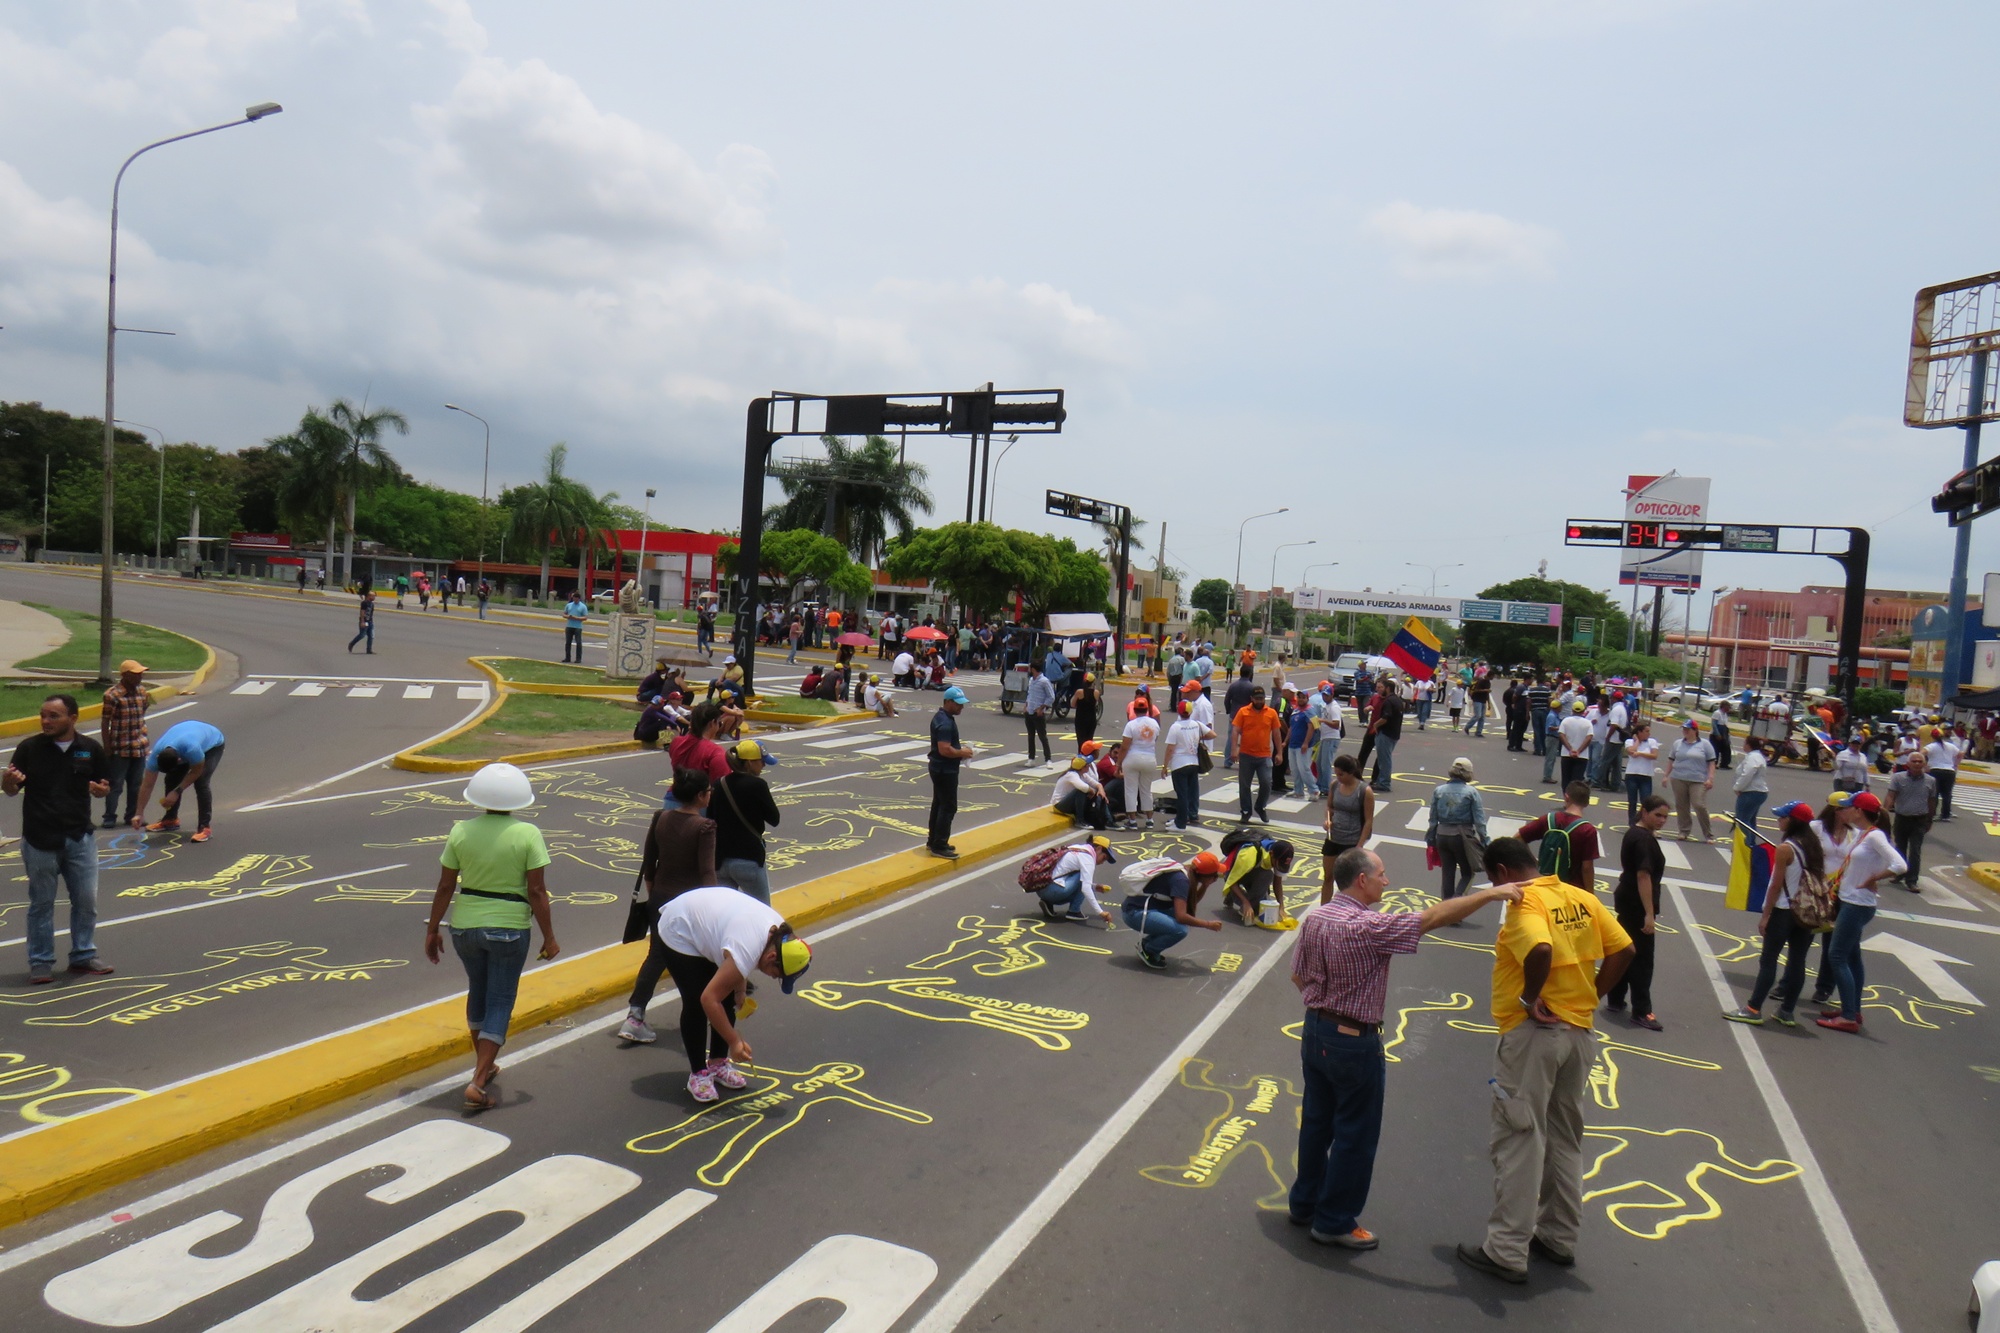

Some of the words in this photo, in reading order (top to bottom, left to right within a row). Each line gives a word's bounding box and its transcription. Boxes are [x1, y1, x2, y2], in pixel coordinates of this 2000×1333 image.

[1634, 502, 1702, 517] OPTICOLOR
[1629, 524, 1658, 546] 34
[1327, 597, 1365, 607] AVENIDA
[1366, 599, 1407, 610] FUERZAS
[1408, 602, 1452, 612] ARMADAS
[735, 578, 750, 658] VZLA
[1551, 903, 1592, 925] ZULIA
[914, 986, 1013, 1009] GERARDO
